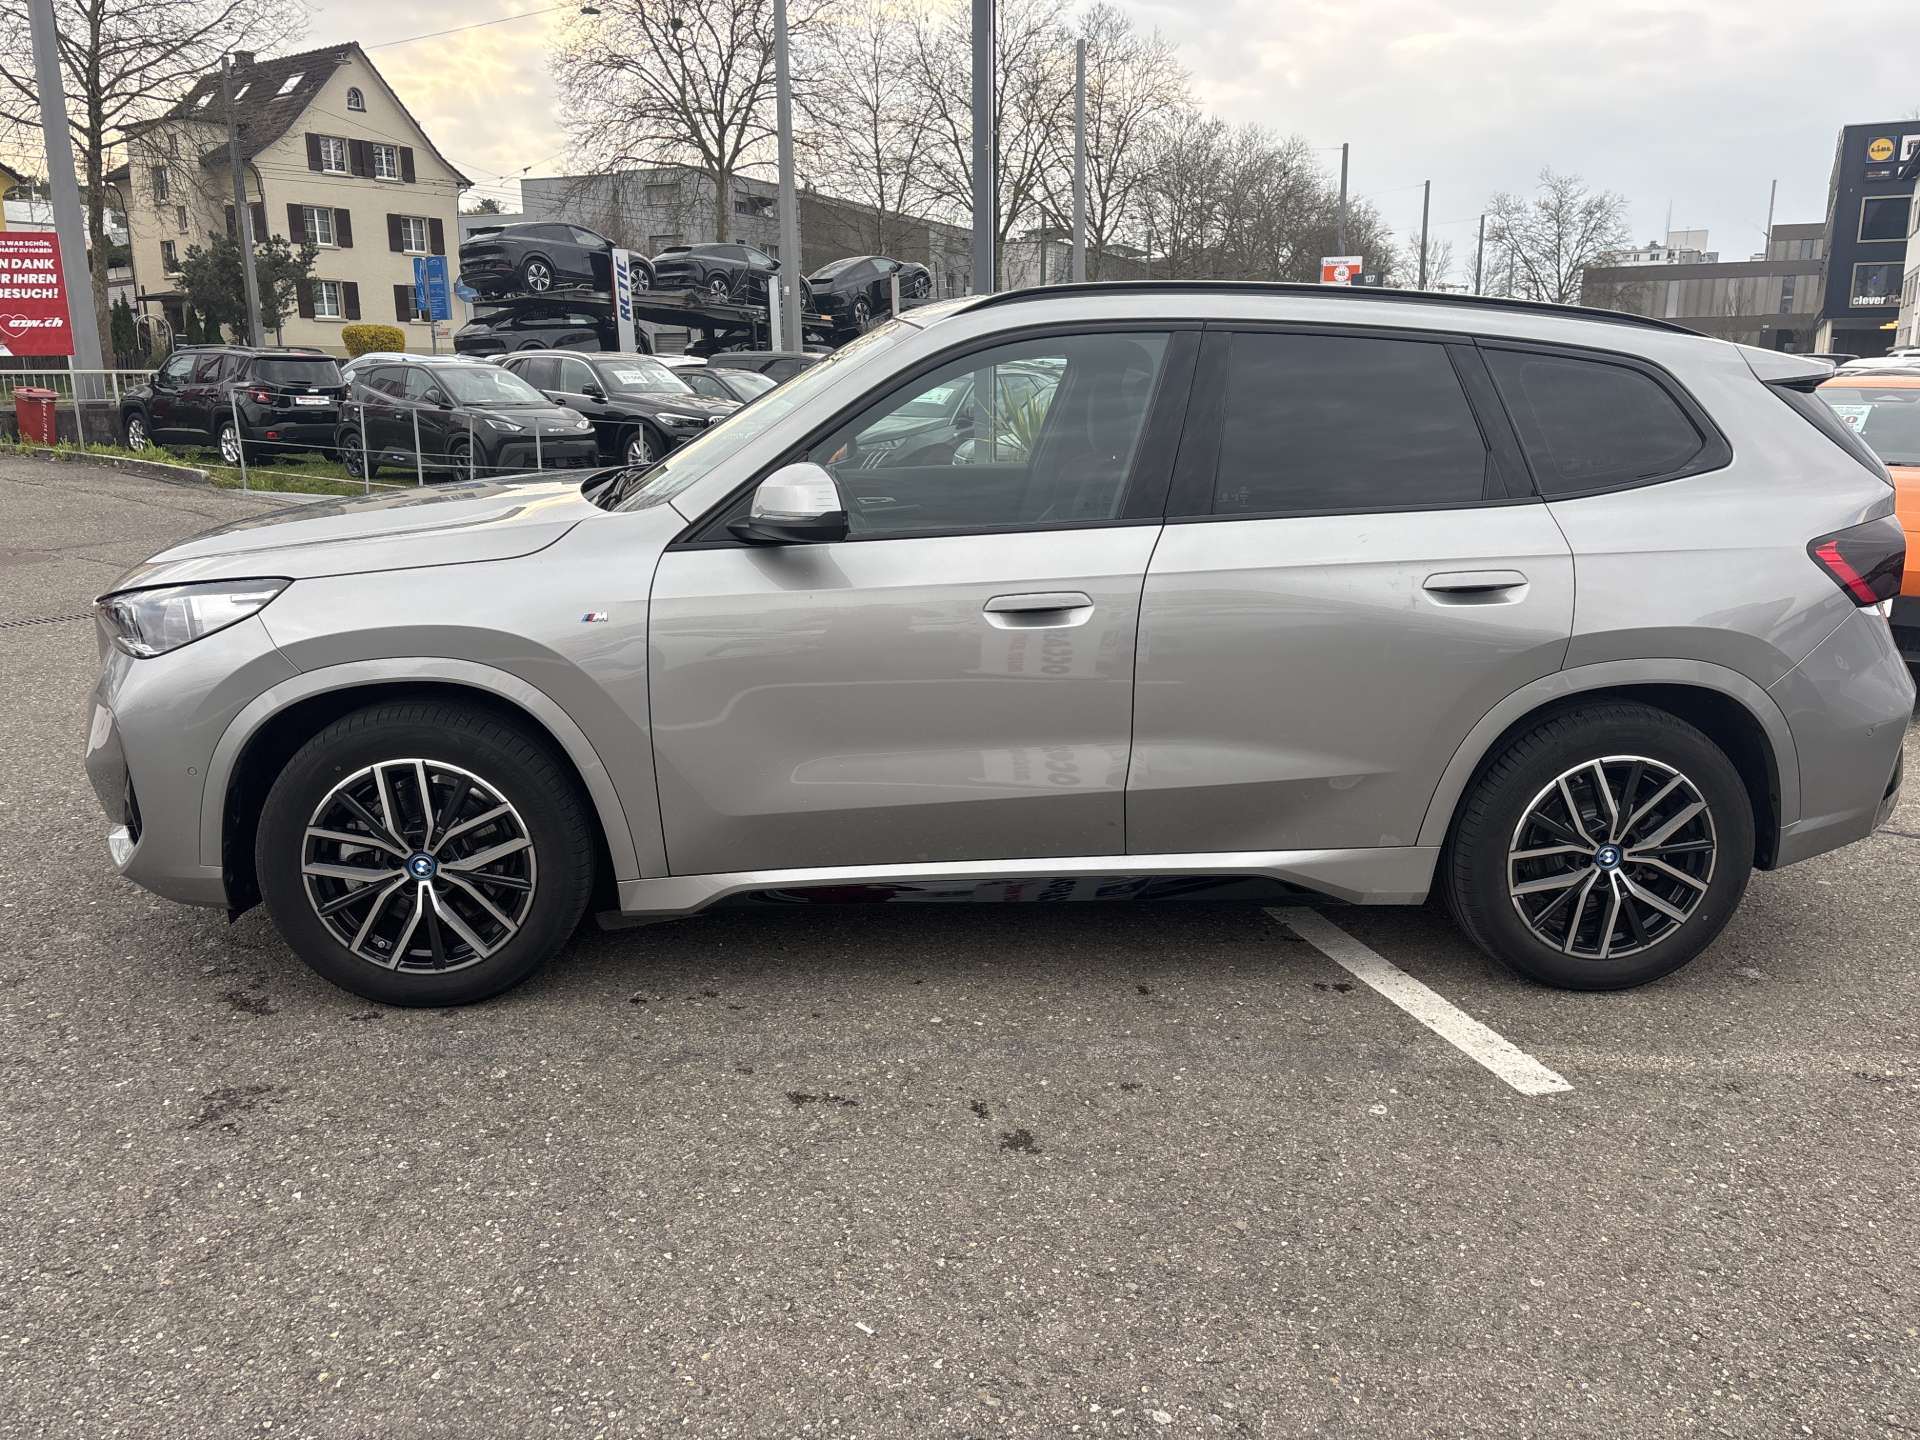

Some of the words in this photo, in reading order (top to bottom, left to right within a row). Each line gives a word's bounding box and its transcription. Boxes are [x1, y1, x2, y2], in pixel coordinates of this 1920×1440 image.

[11, 258, 54, 269] DANK
[13, 273, 57, 284] IHREN
[1852, 295, 1887, 305] clever
